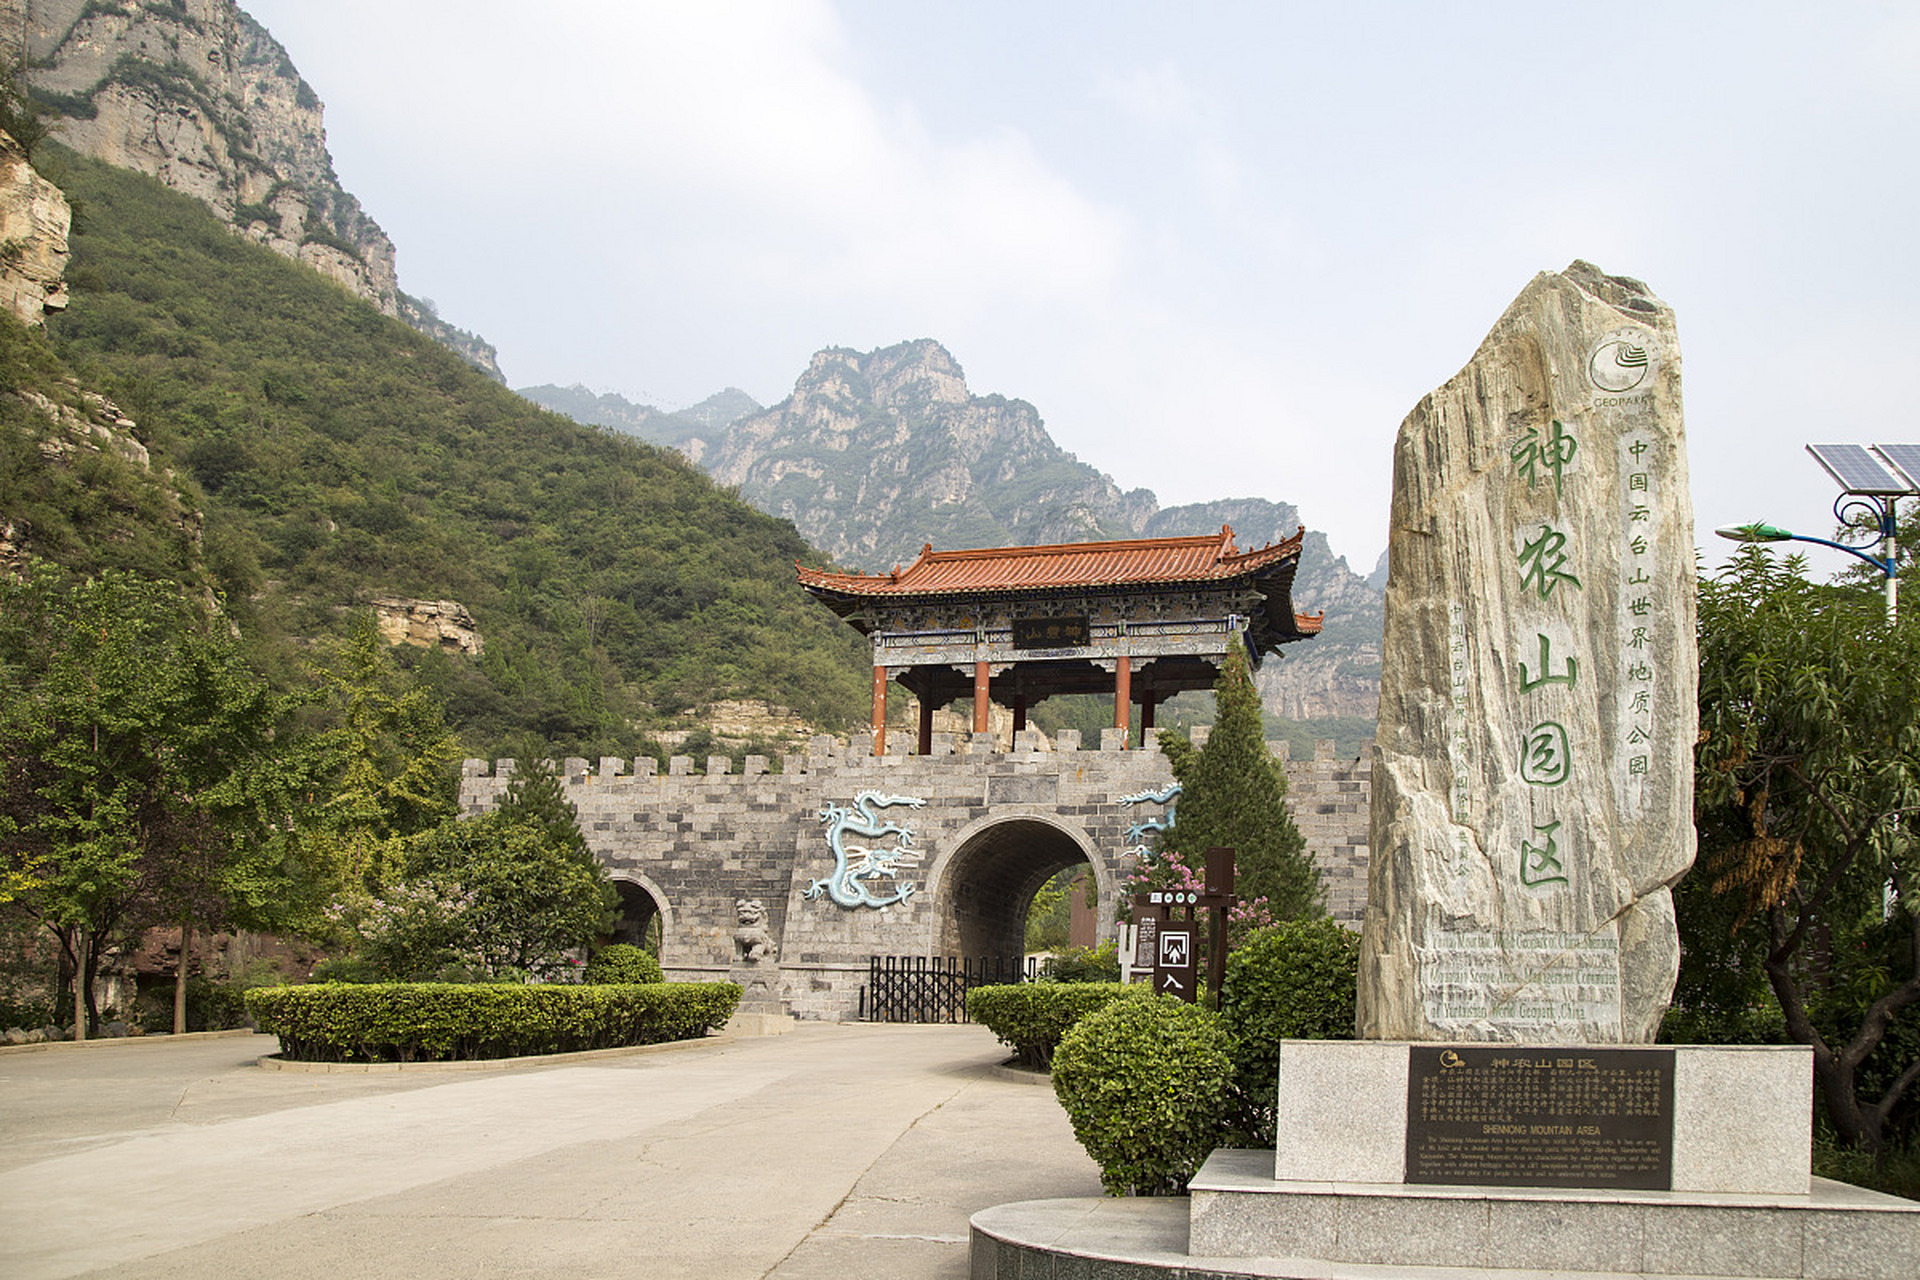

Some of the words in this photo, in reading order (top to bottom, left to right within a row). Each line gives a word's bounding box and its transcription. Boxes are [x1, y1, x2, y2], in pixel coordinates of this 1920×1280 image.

[1593, 396, 1647, 407] GEOPARK
[1511, 420, 1583, 889] 神农山园区
[1628, 439, 1653, 776] 中国云台山世界地质公园
[1482, 1124, 1528, 1135] SHENNONG
[1530, 1125, 1573, 1136] MOUNTAIN
[1576, 1125, 1601, 1136] AREA
